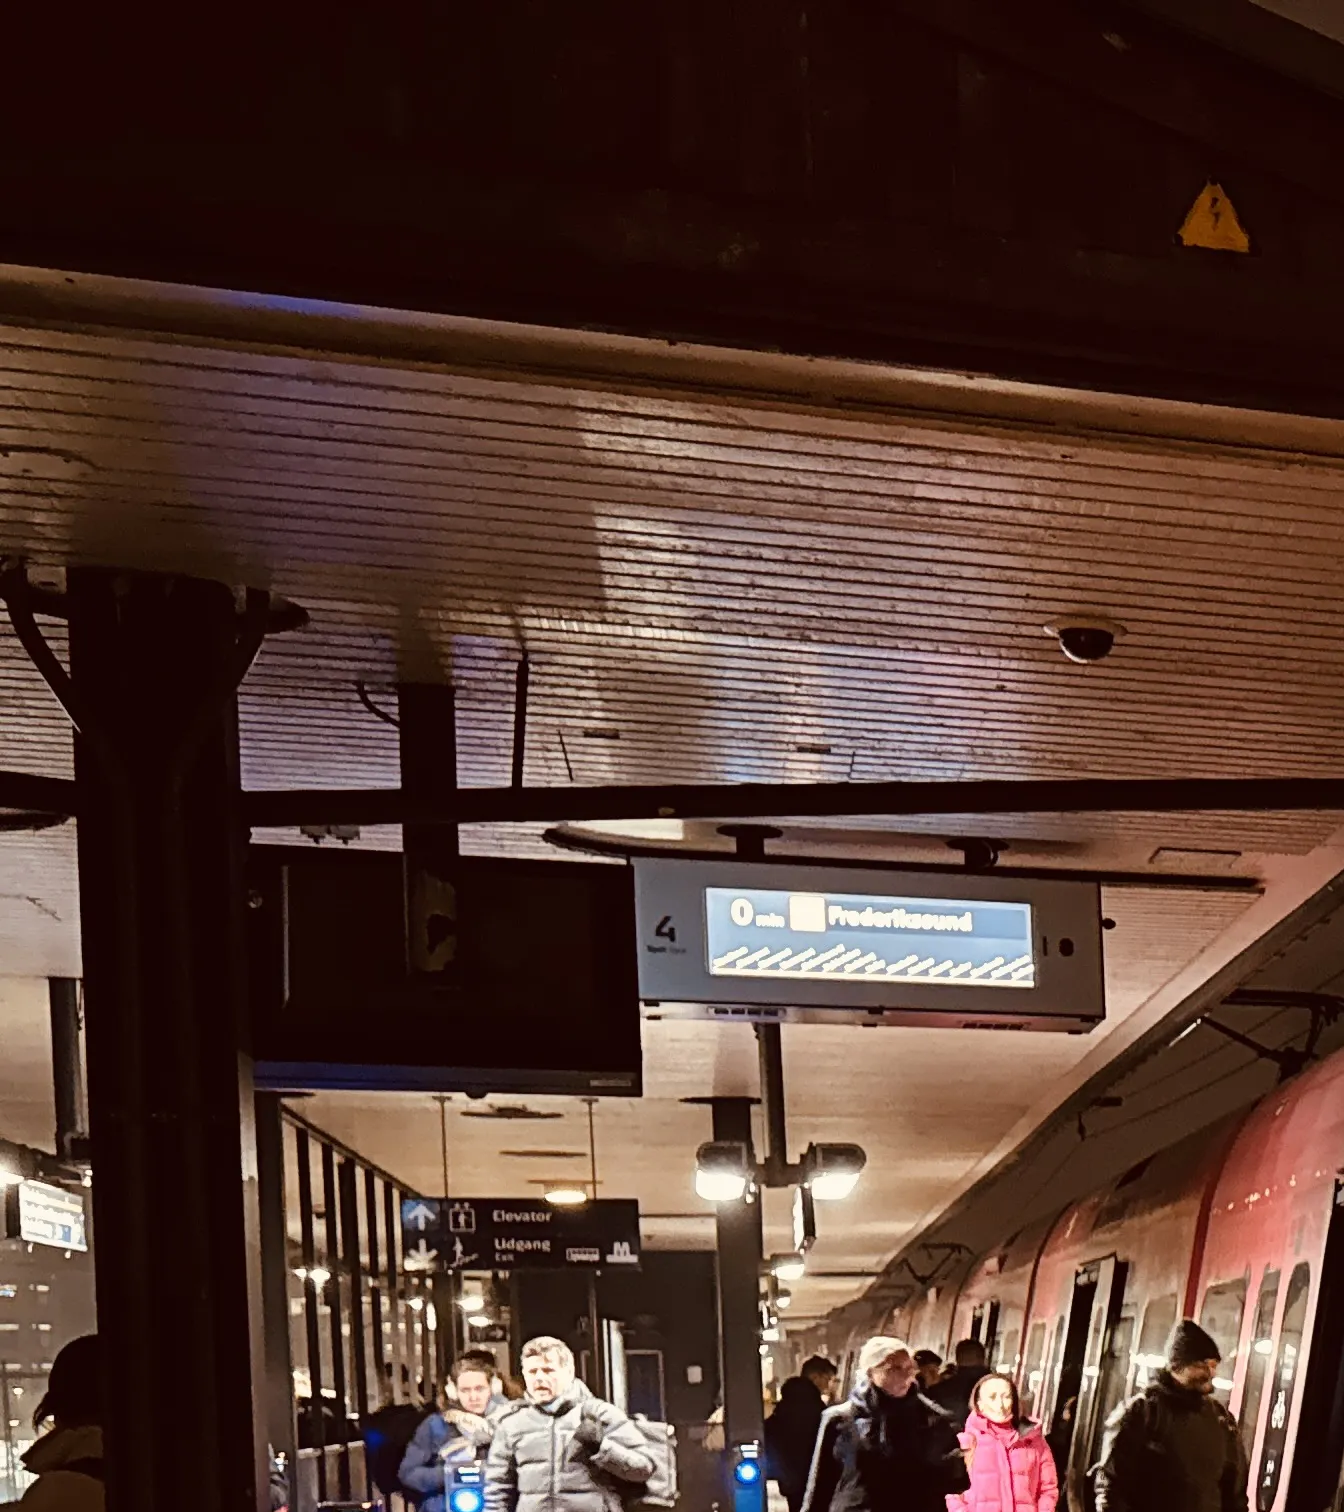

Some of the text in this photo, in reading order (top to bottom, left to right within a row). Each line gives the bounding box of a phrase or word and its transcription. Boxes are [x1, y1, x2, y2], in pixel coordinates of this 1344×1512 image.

[730, 897, 754, 927] 0
[655, 915, 676, 942] 4
[493, 1209, 553, 1223] Elevator
[494, 1237, 551, 1252] Udgang
